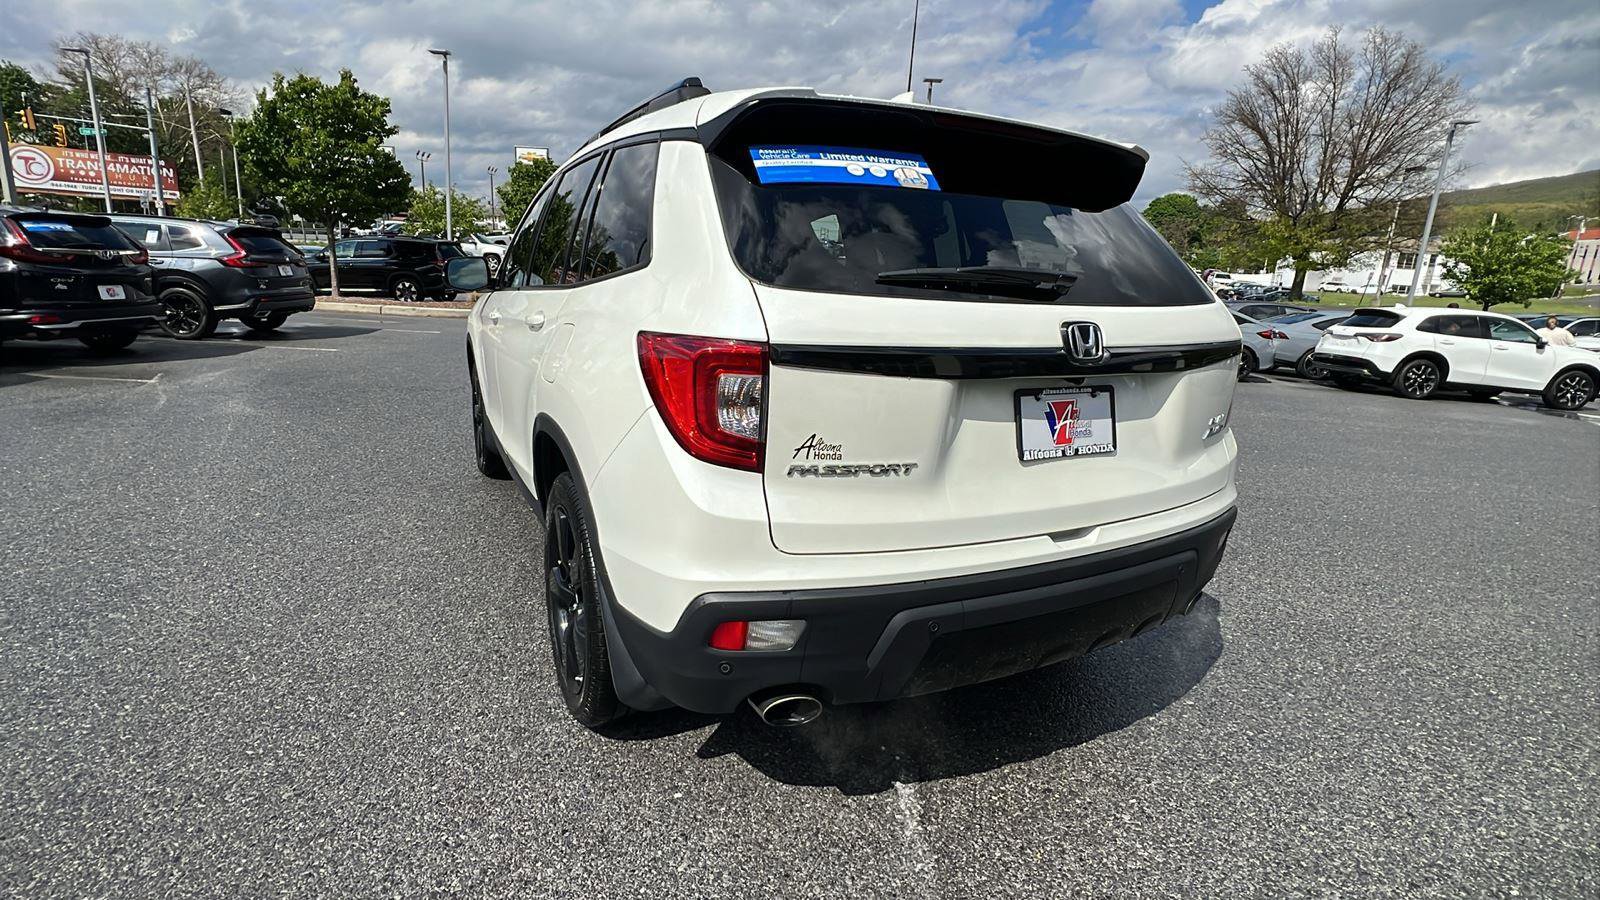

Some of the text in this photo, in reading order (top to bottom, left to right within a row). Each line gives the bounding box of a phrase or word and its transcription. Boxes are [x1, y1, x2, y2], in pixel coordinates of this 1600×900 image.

[820, 153, 919, 167] Limited Warranty
[793, 434, 842, 459] Altoona
[1024, 447, 1062, 460] Altoona
[1078, 443, 1114, 454] HONDA
[813, 452, 842, 460] Honda
[787, 463, 919, 477] PASSPORT
